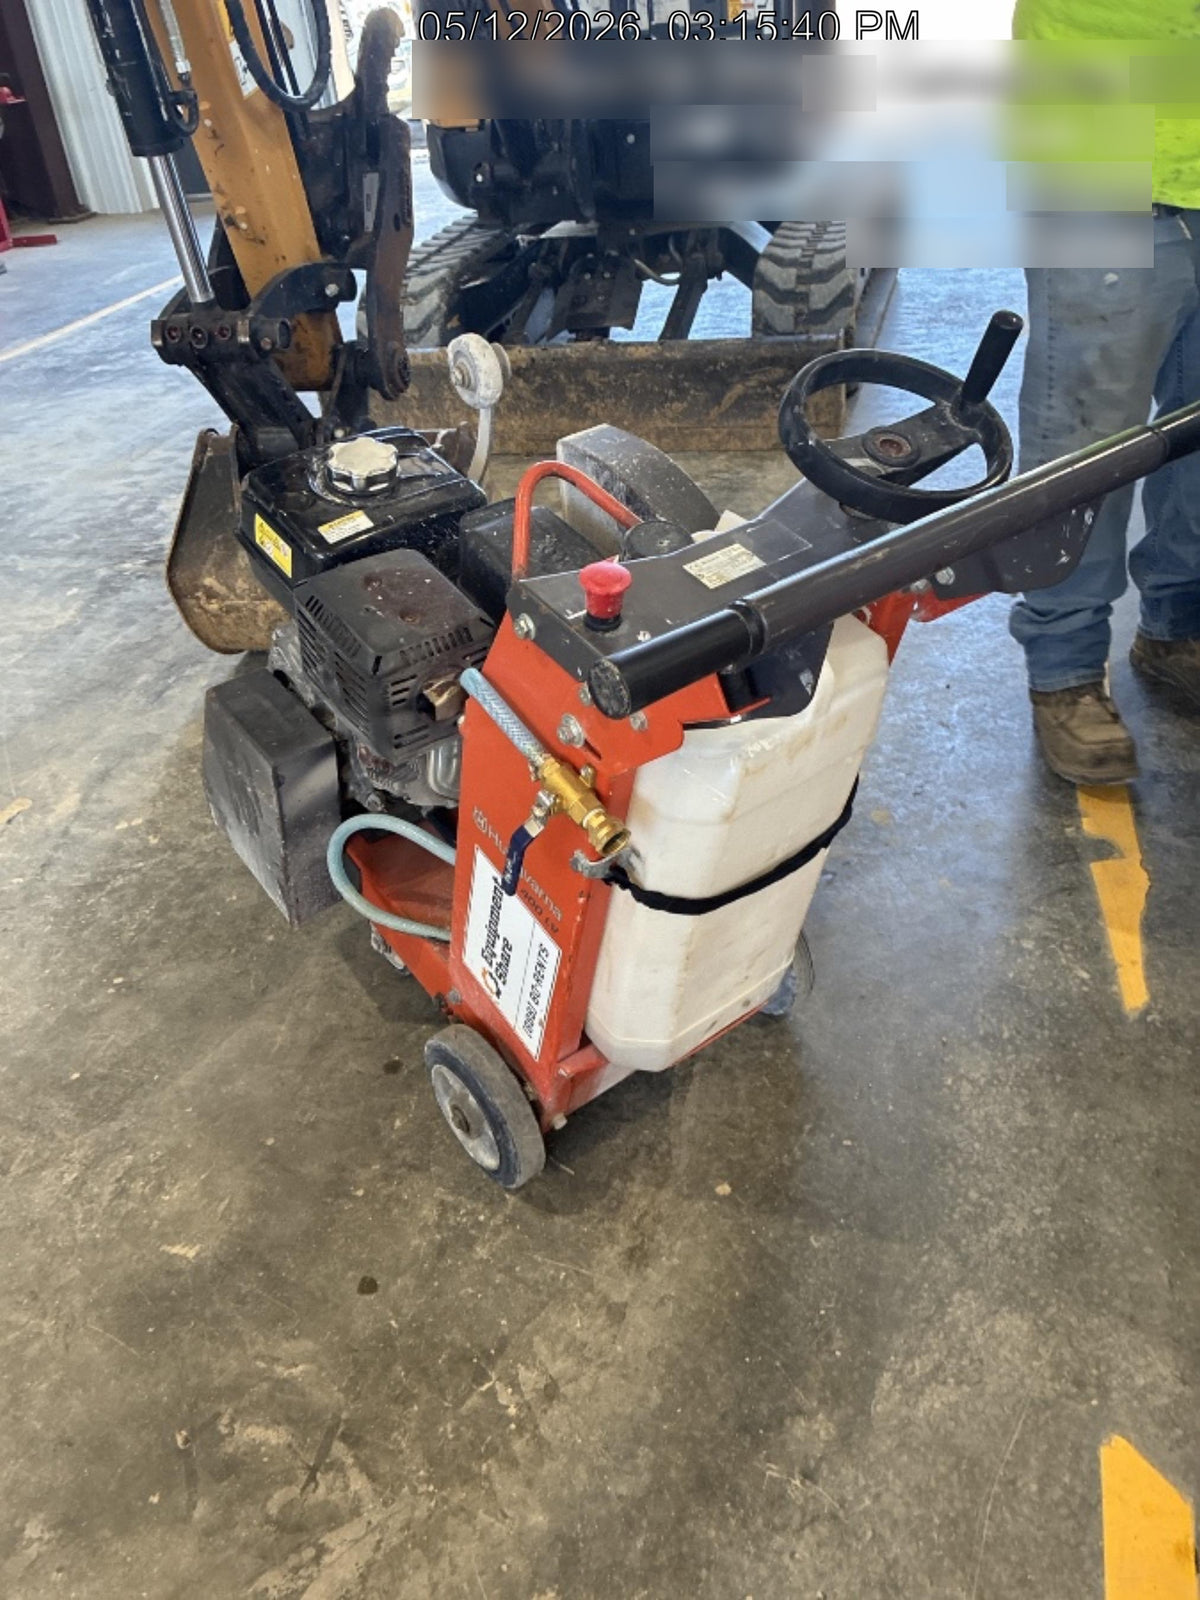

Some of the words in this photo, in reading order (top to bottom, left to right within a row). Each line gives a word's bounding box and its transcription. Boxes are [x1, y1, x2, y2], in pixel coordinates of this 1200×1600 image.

[488, 825, 562, 922] Huvarna
[481, 875, 504, 970] Equipment
[495, 936, 513, 986] Share
